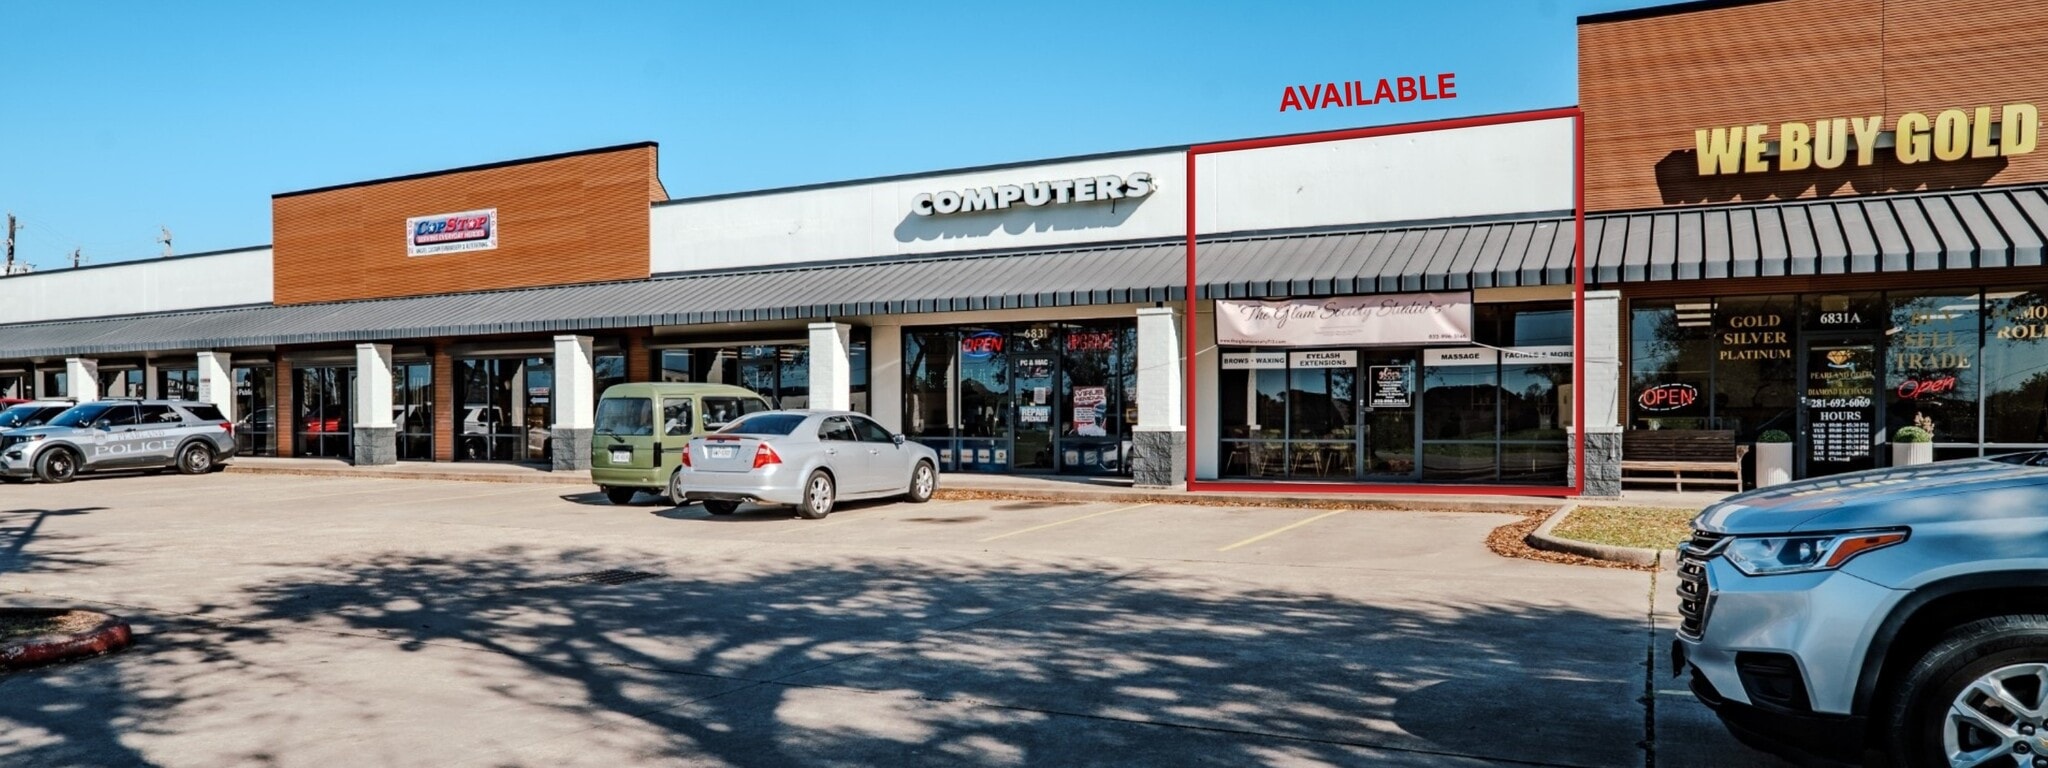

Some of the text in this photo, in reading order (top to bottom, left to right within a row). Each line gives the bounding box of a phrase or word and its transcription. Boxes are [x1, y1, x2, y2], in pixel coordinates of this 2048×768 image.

[1695, 103, 2039, 176] WE BUY GOLD
[911, 171, 1151, 216] COMPUTERS
[1240, 304, 1269, 321] The
[1273, 305, 1316, 329] Glam
[1320, 301, 1372, 322] Society
[1730, 315, 1781, 328] GOLD
[1820, 312, 1861, 324] 6831A
[962, 337, 1003, 352] OPEN
[1031, 338, 1039, 348] C
[1723, 332, 1787, 345] SILVER
[1441, 352, 1480, 360] MASSAGE
[1719, 349, 1791, 360] PLATINUM
[1897, 351, 1971, 369] TRADE
[1074, 388, 1105, 397] VIRUS
[1808, 388, 1873, 396] DIAMOND EXCHANGE
[1897, 375, 1956, 398] Open
[1643, 389, 1693, 405] OPEN
[1811, 398, 1870, 408] 281-692-6069
[1021, 407, 1048, 416] REPAIR
[1820, 411, 1861, 421] HOURS
[94, 439, 176, 456] POLICE
